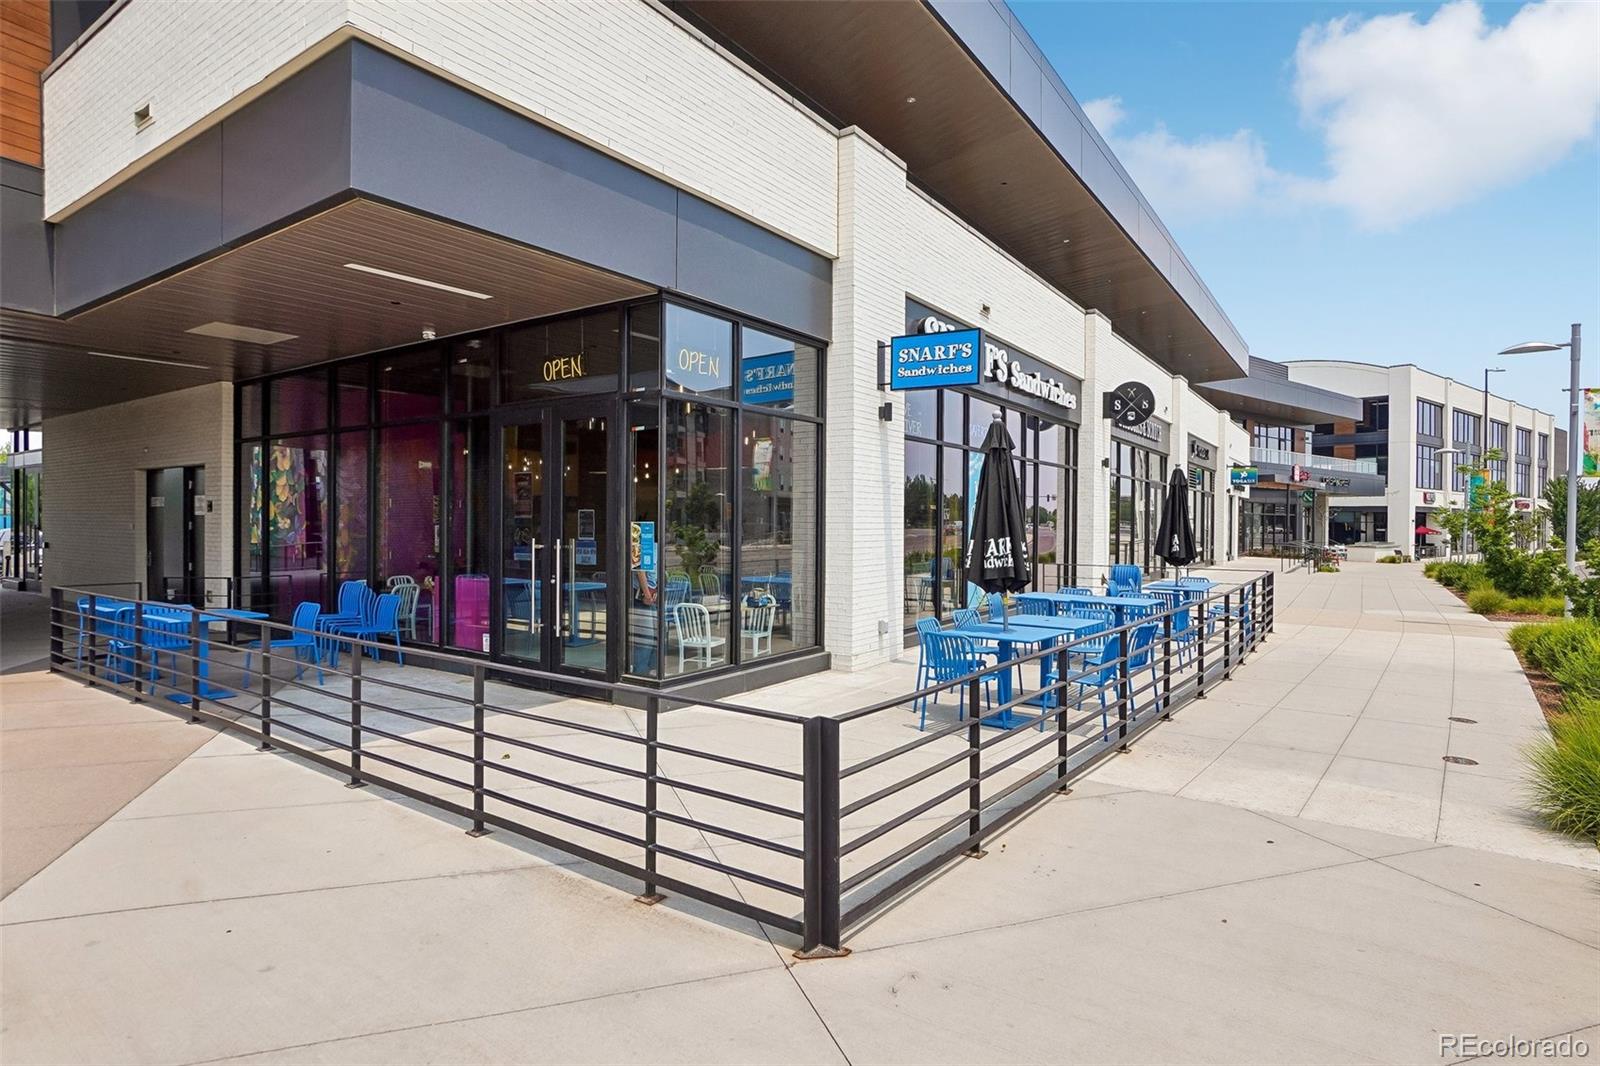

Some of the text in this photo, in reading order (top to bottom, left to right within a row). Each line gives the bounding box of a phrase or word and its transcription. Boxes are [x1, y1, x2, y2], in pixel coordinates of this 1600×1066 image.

[679, 349, 719, 378] OPEN
[899, 343, 972, 363] SNARF'S
[544, 354, 582, 382] OPEN
[898, 363, 972, 377] Sandwiches
[1011, 361, 1077, 409] Sandwiches
